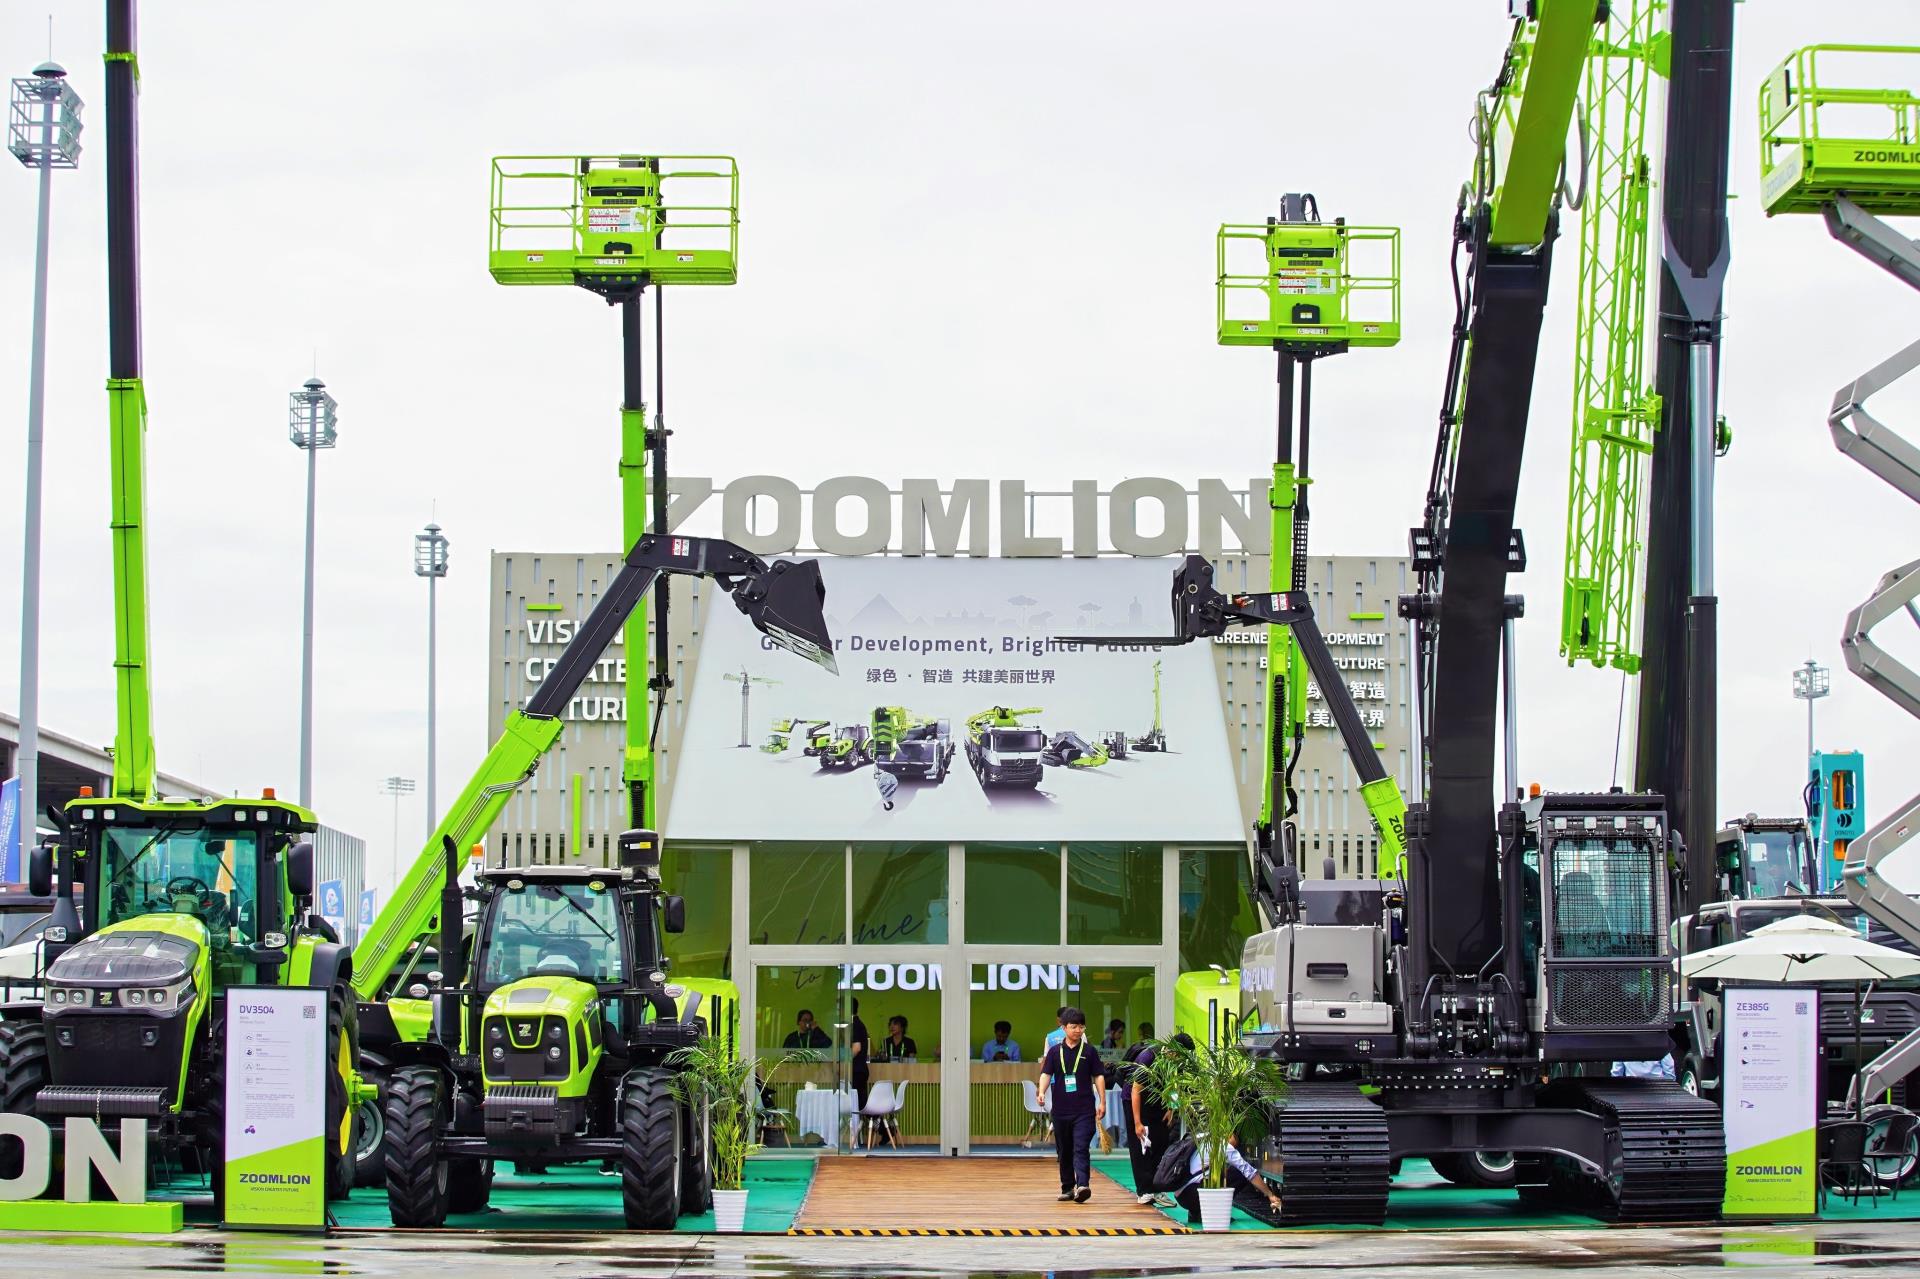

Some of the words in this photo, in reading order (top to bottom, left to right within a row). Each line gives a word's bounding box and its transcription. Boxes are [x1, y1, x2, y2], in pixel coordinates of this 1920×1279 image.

[646, 475, 1272, 557] ZOOMLION
[851, 635, 993, 655] Development,
[1002, 636, 1084, 656] Brighter
[867, 668, 898, 683] 绿色
[922, 668, 953, 683] 智造
[963, 668, 1055, 684] 共建美丽世界
[239, 1005, 275, 1014] DV3504
[1736, 1002, 1769, 1011] ZE385G
[0, 1113, 148, 1203] ON
[1735, 1166, 1802, 1175] ZOOMLION
[239, 1173, 311, 1184] ZOOMLION
